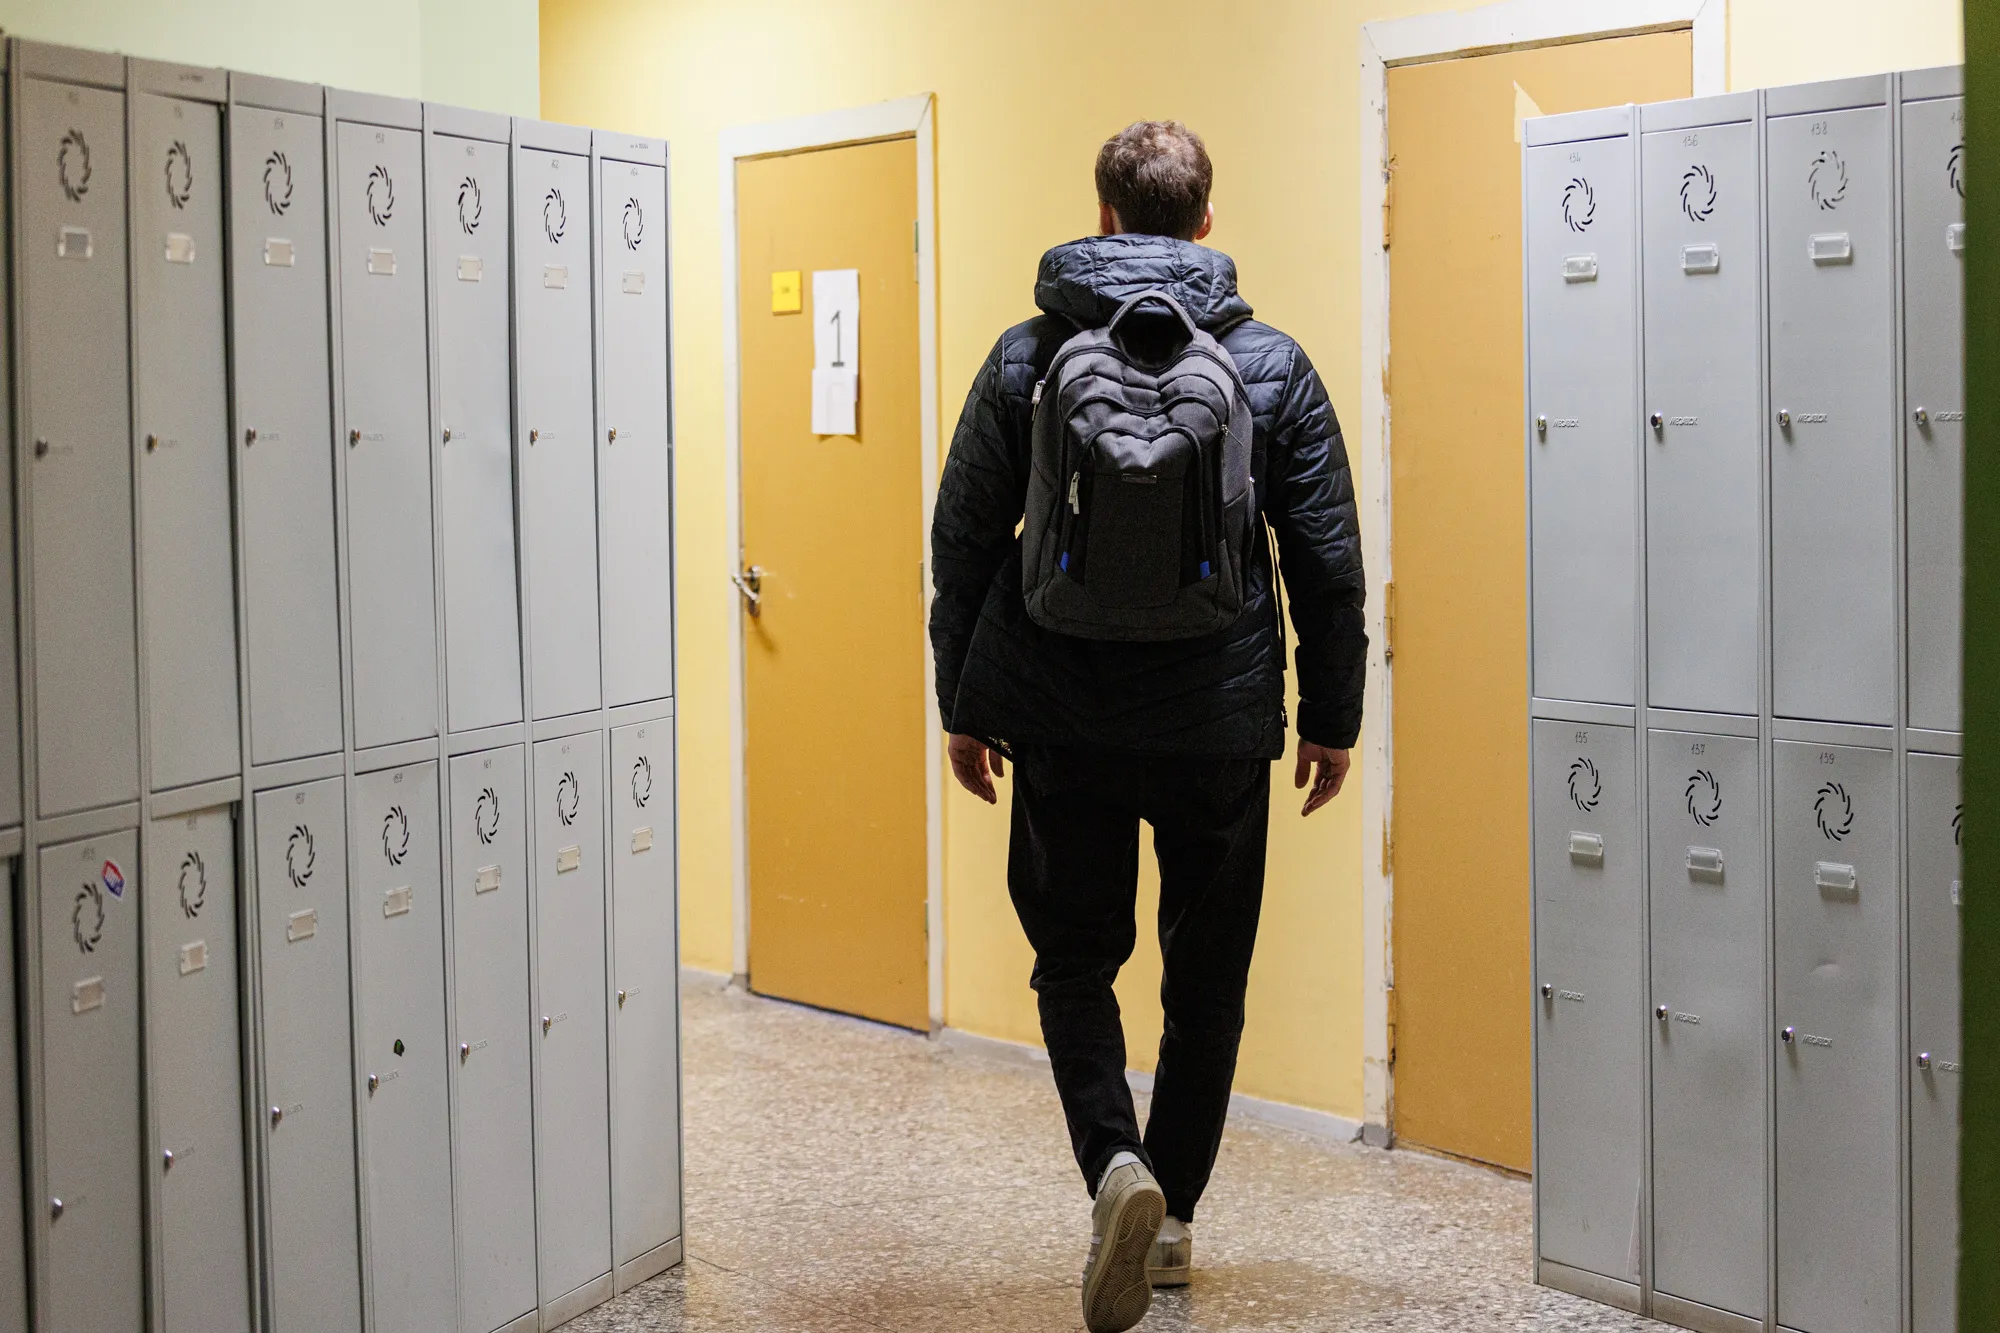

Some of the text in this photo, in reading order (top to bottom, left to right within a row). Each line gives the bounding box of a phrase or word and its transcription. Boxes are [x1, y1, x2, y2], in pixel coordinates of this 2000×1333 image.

[1810, 121, 1828, 136] 138
[1682, 133, 1699, 147] 136
[1568, 151, 1581, 163] 134
[830, 310, 845, 368] 1
[1574, 731, 1588, 744] 135
[1690, 743, 1705, 756] 137
[1818, 752, 1835, 765] 139
